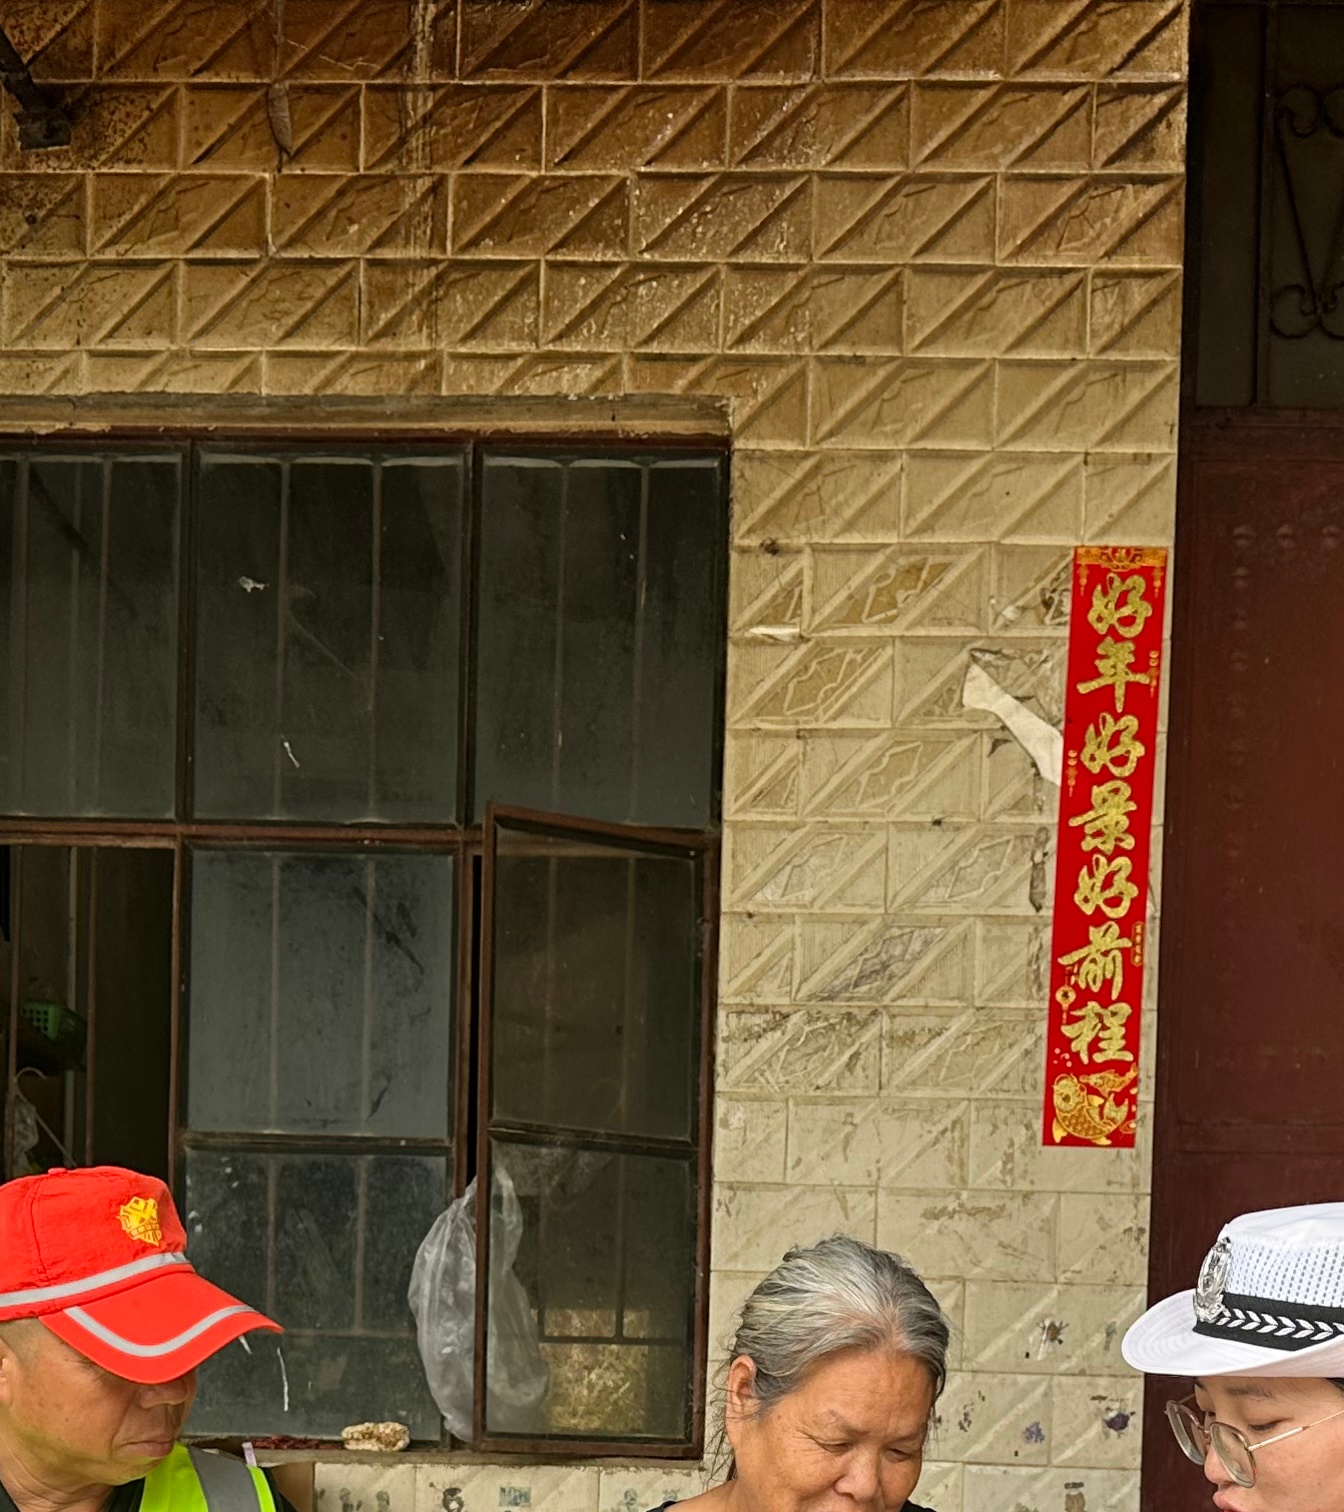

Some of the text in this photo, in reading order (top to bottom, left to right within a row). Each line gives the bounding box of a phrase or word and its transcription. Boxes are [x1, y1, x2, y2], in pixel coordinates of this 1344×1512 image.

[1058, 572, 1153, 1065] 好年好景好前程
